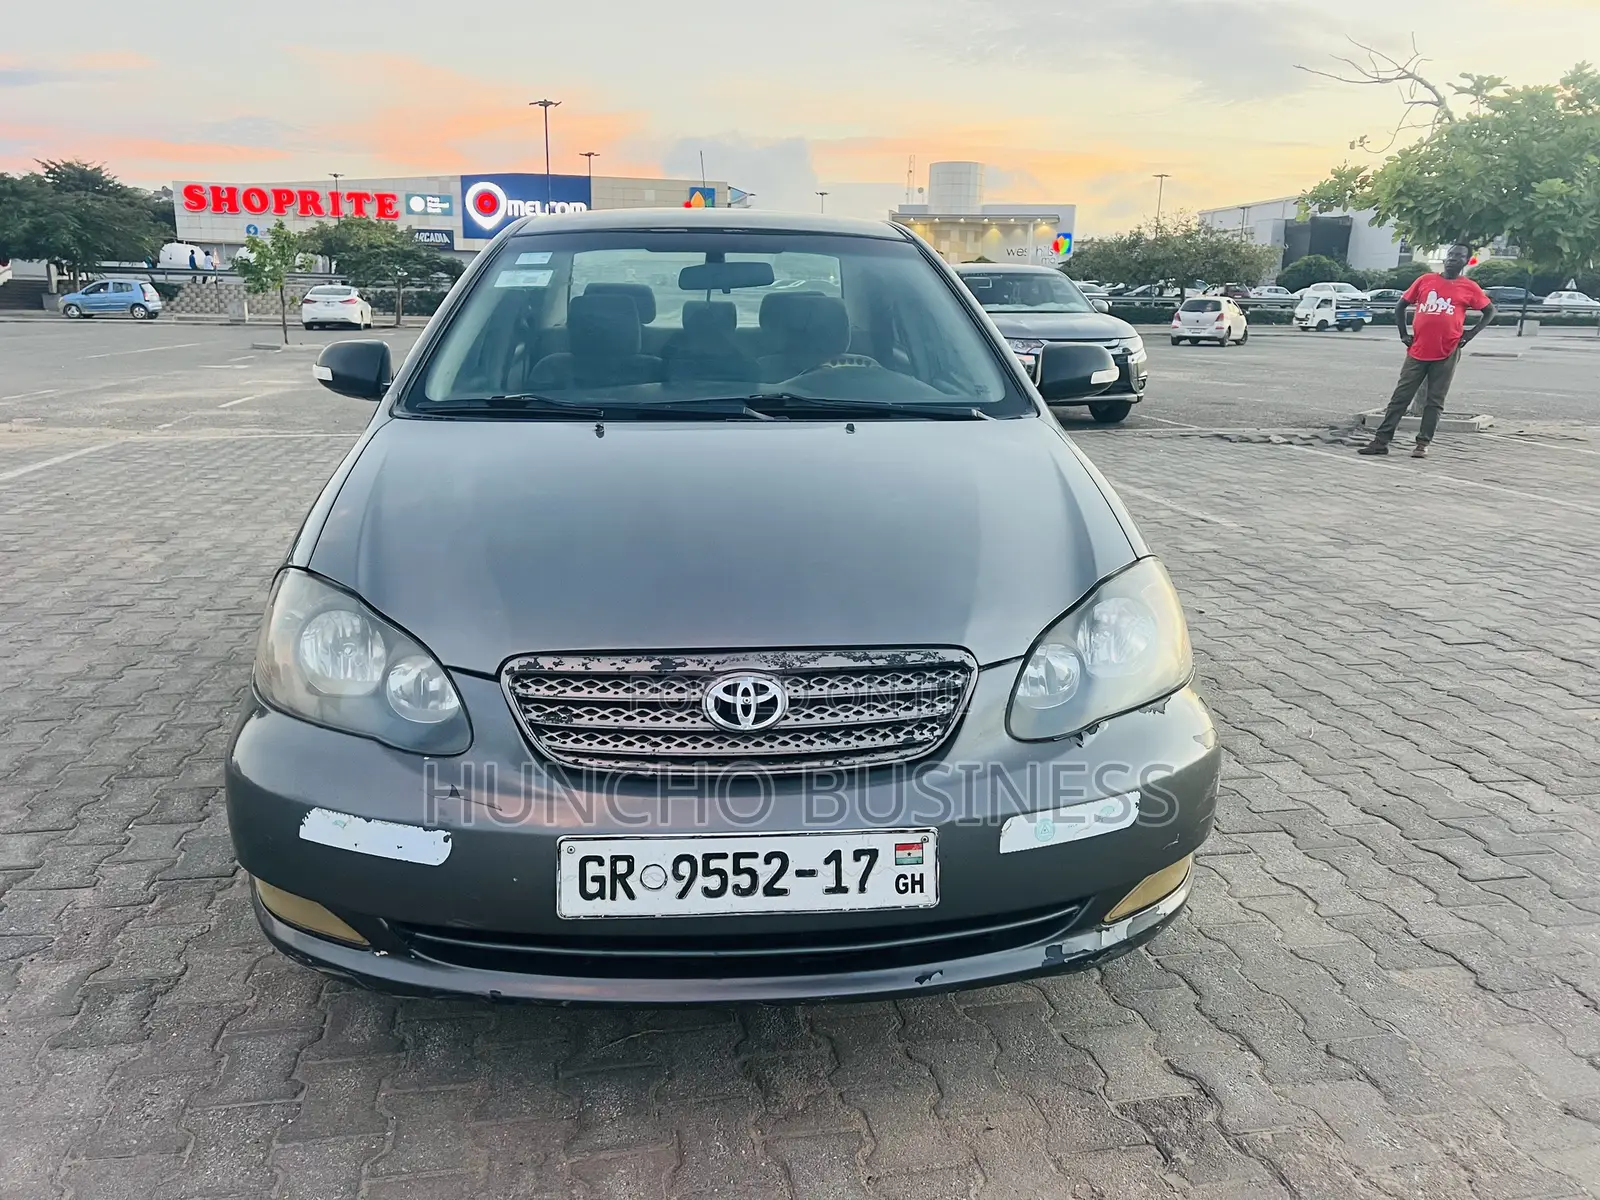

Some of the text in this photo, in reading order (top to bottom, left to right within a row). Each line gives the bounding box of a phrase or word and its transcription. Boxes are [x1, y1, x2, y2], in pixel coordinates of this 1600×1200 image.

[182, 184, 400, 220] SHOPRITE
[412, 232, 451, 243] ARCADIA
[1006, 247, 1028, 257] wes
[578, 848, 880, 900] GR 9552-17
[894, 873, 925, 894] GH
